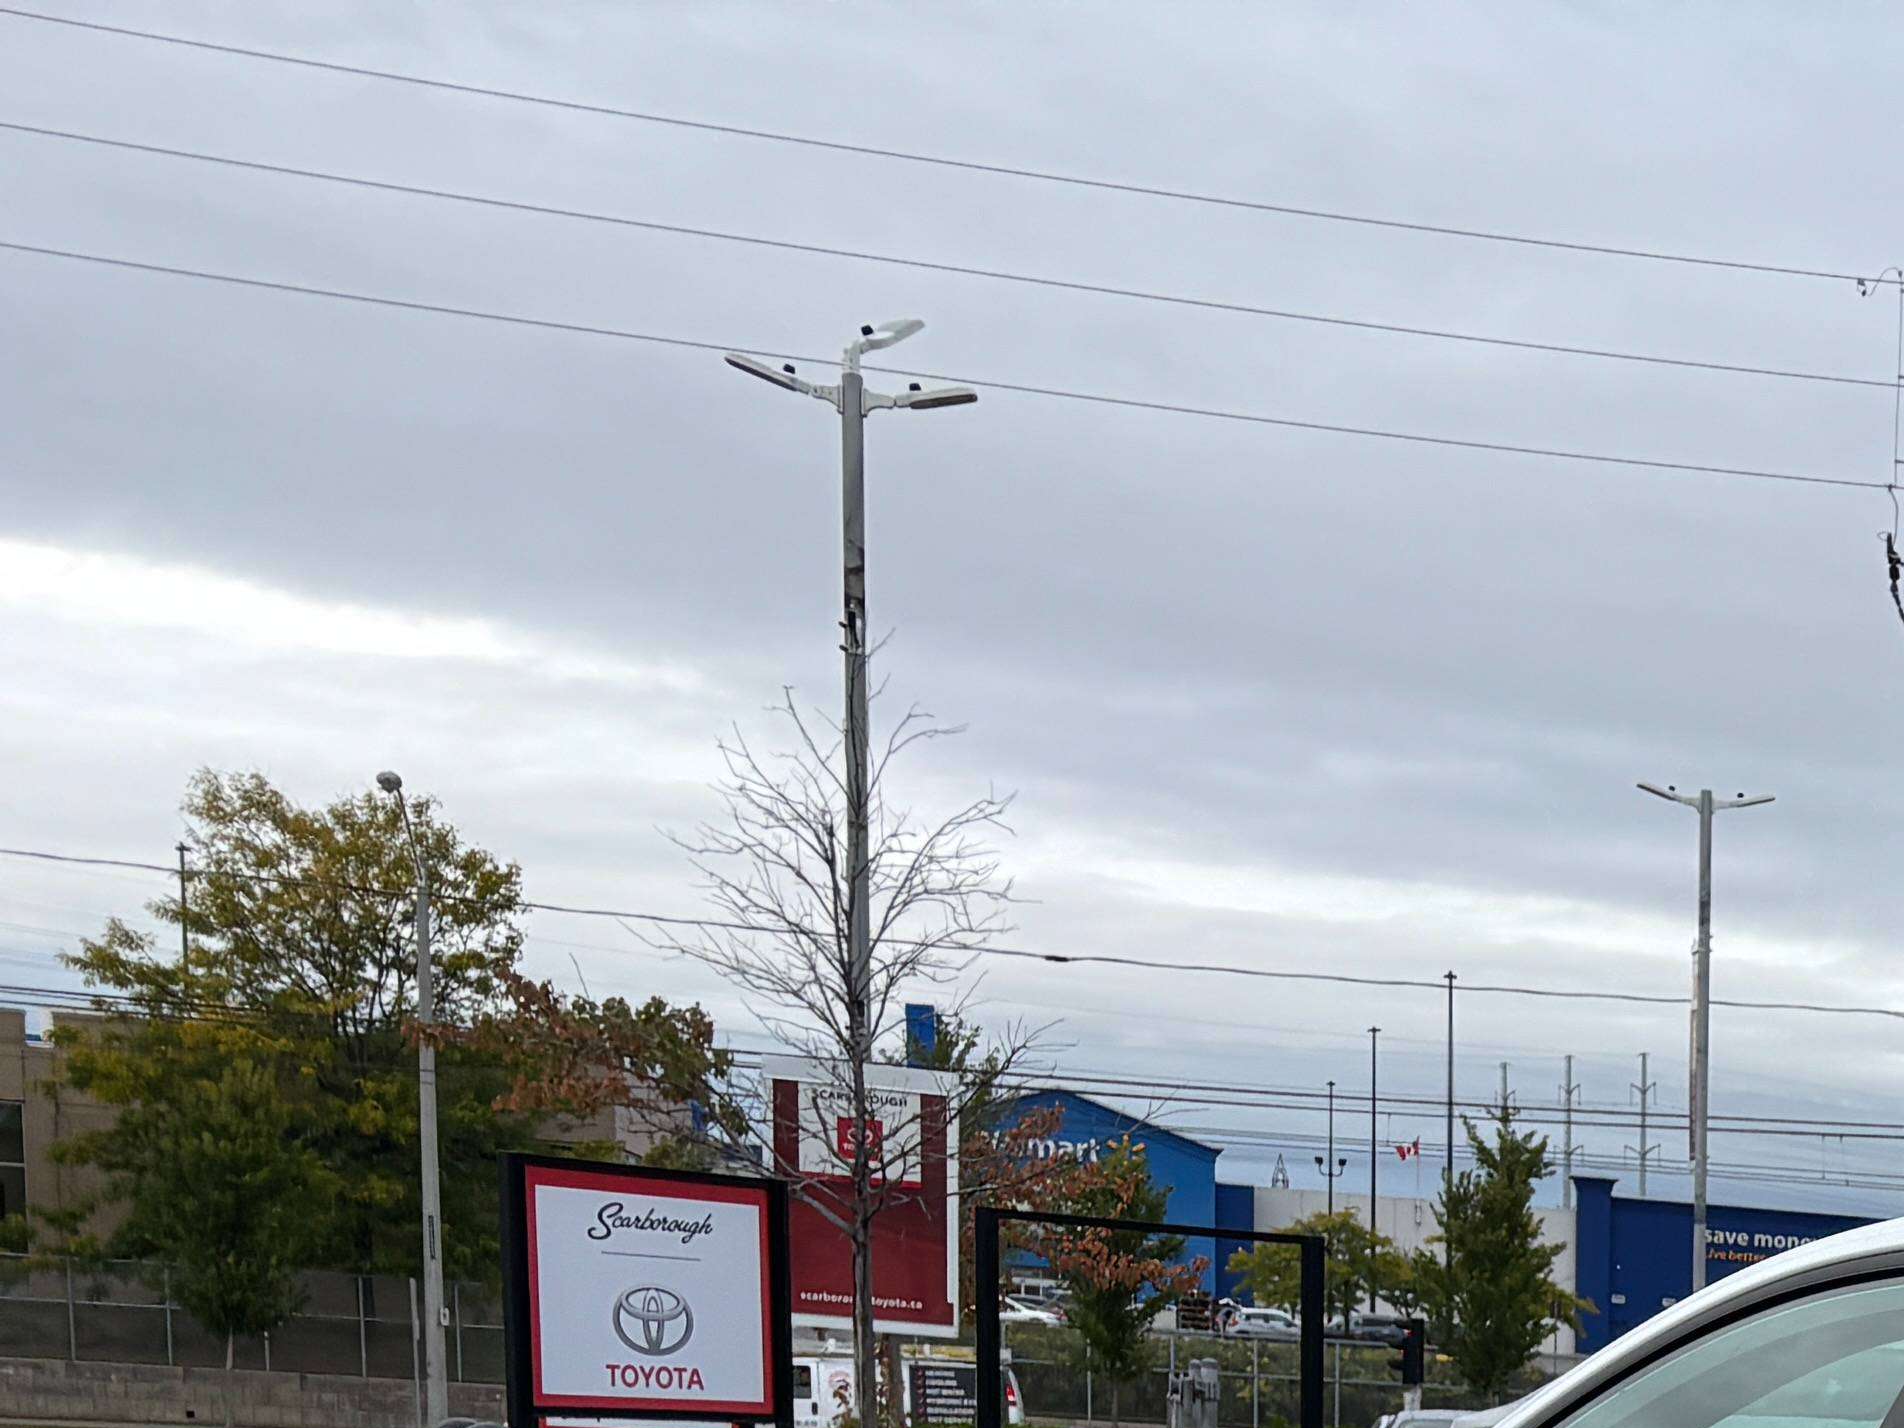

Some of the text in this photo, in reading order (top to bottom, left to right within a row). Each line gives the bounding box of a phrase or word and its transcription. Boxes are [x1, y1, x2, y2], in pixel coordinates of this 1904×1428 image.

[587, 1202, 713, 1244] Scarborough
[1705, 1230, 1815, 1249] save mone
[605, 1364, 704, 1391] TOYOTA
